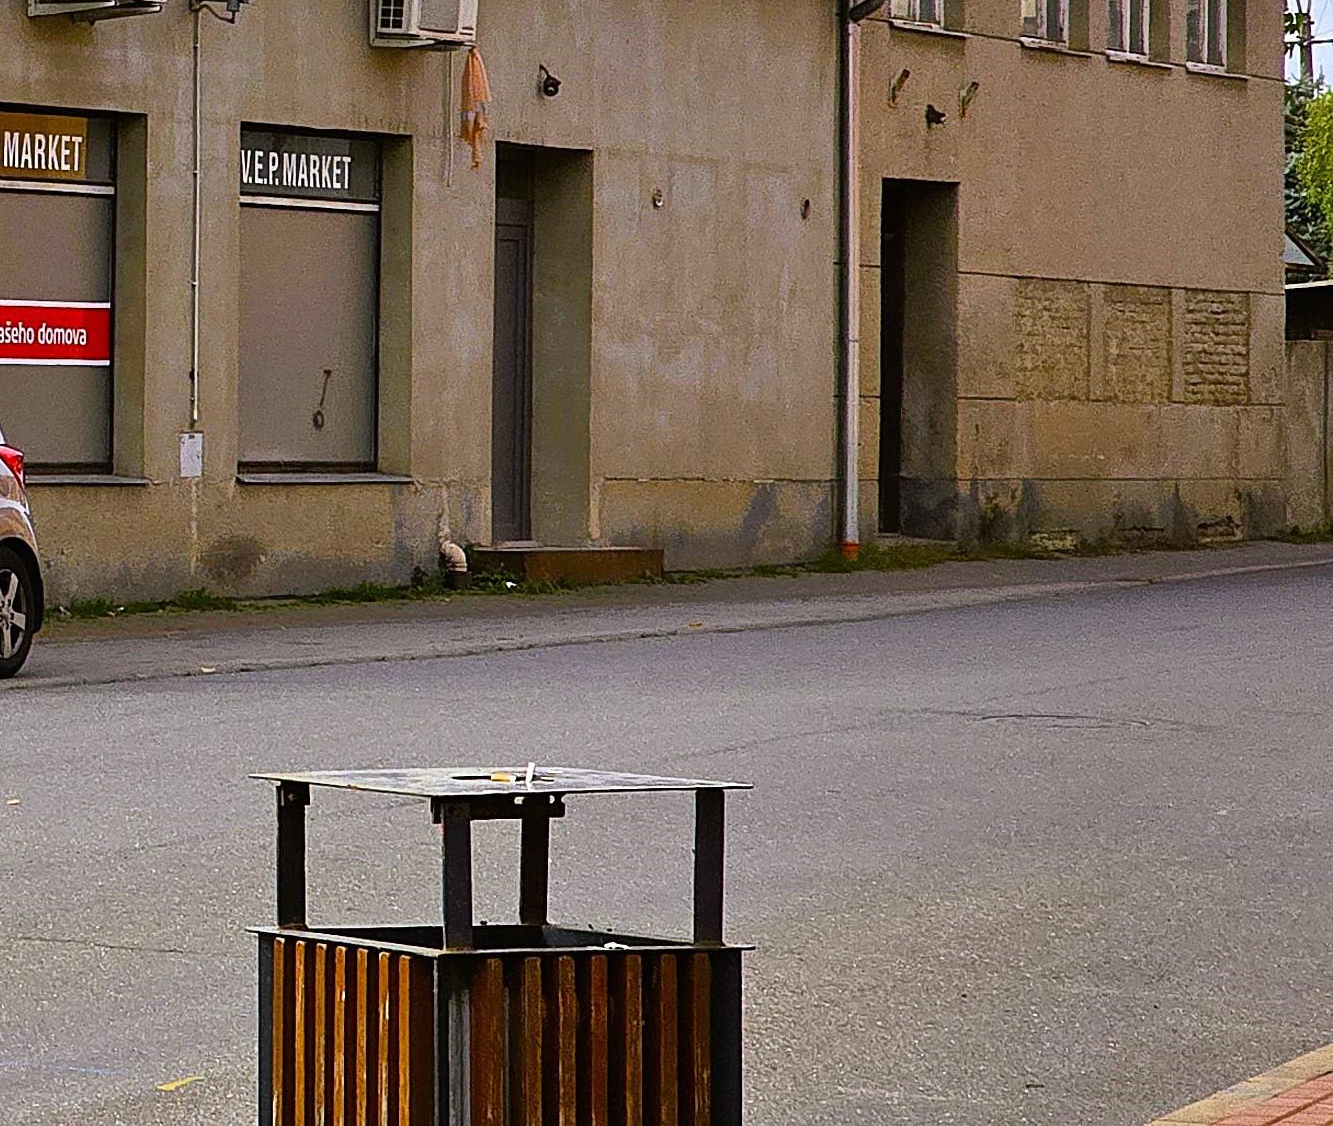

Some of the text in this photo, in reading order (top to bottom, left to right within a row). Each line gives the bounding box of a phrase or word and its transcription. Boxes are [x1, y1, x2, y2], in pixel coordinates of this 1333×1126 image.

[3, 131, 83, 171] MARKET
[241, 150, 351, 189] V.E.P. MARKET
[37, 322, 87, 345] domova
